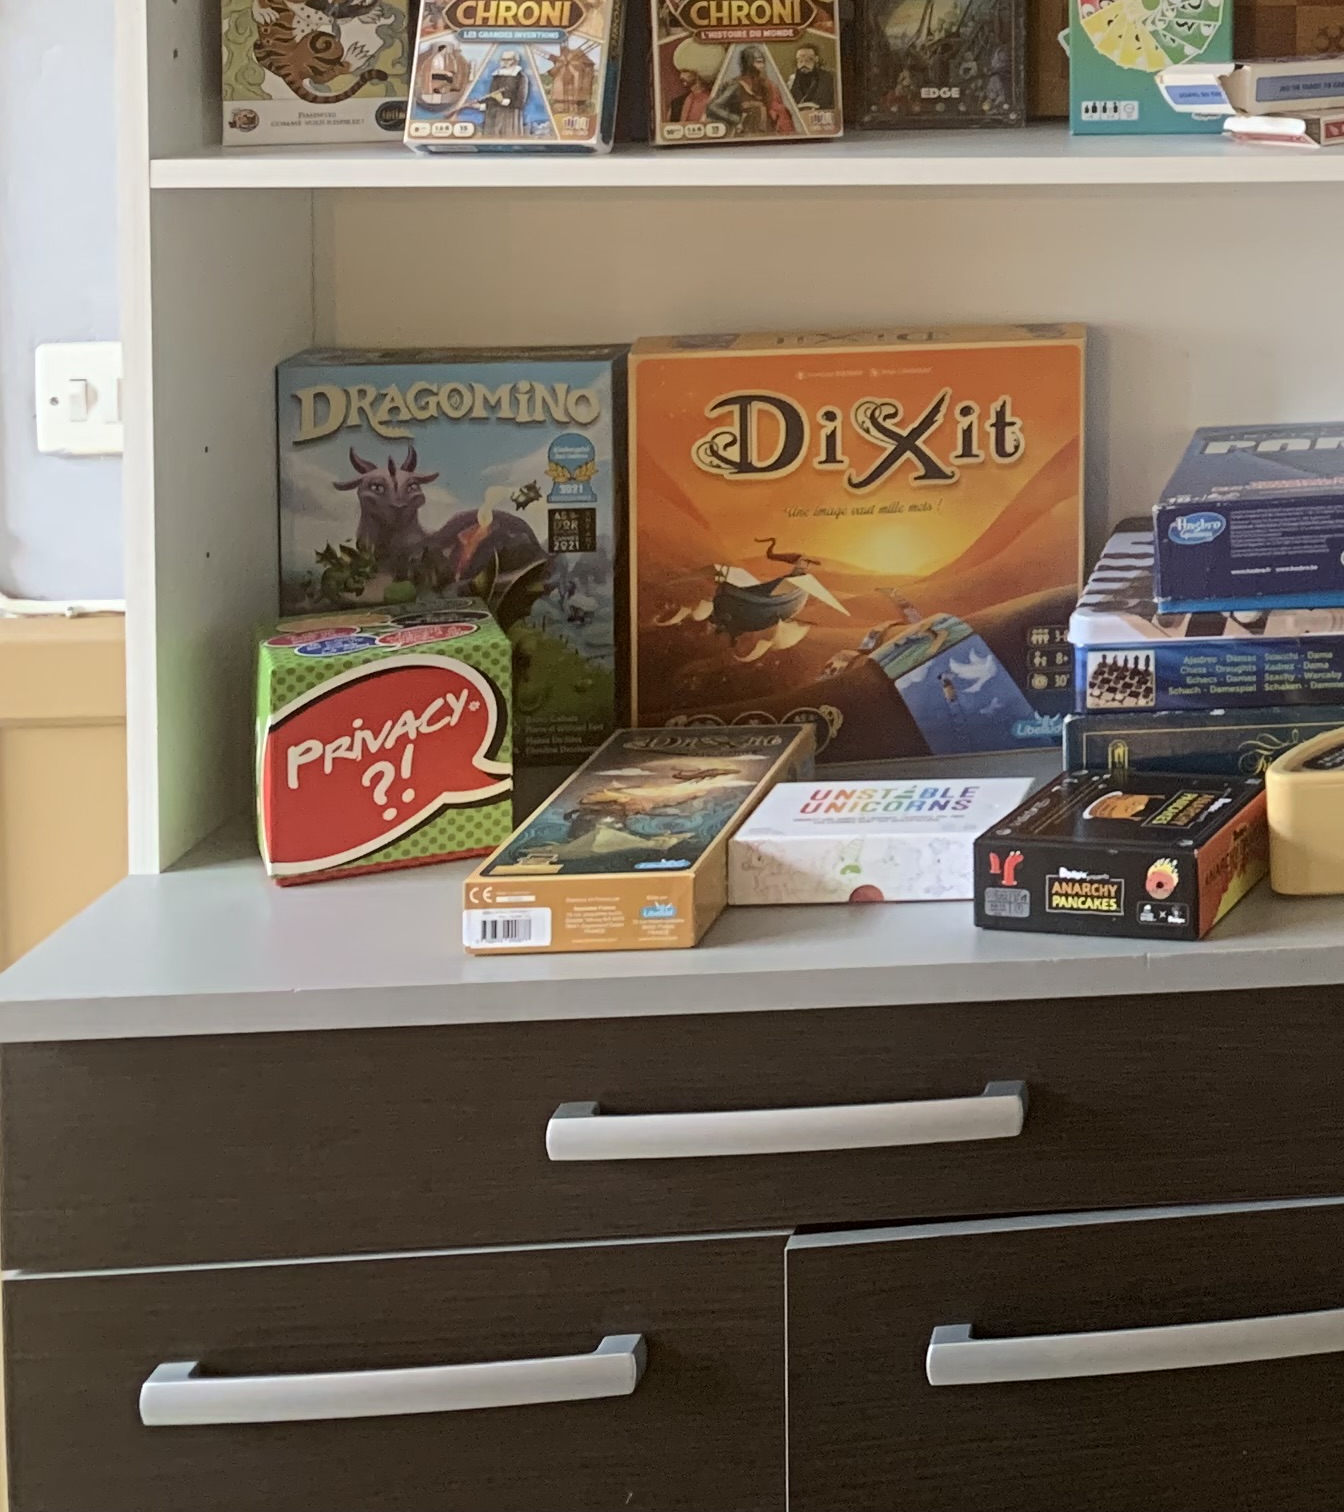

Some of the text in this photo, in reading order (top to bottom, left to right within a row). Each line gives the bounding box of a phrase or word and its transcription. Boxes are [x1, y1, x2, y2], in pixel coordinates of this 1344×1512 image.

[456, 0, 573, 27] CHRONI
[689, 0, 801, 27] CHRONI
[763, 28, 795, 38] MONDE
[920, 87, 960, 98] EDGE
[1177, 513, 1221, 532] Hasbro
[809, 786, 980, 802] UNSTABLE
[800, 799, 972, 815] UNICORNS
[1051, 880, 1118, 896] ANARCHY
[1051, 895, 1118, 911] PANCAKES
